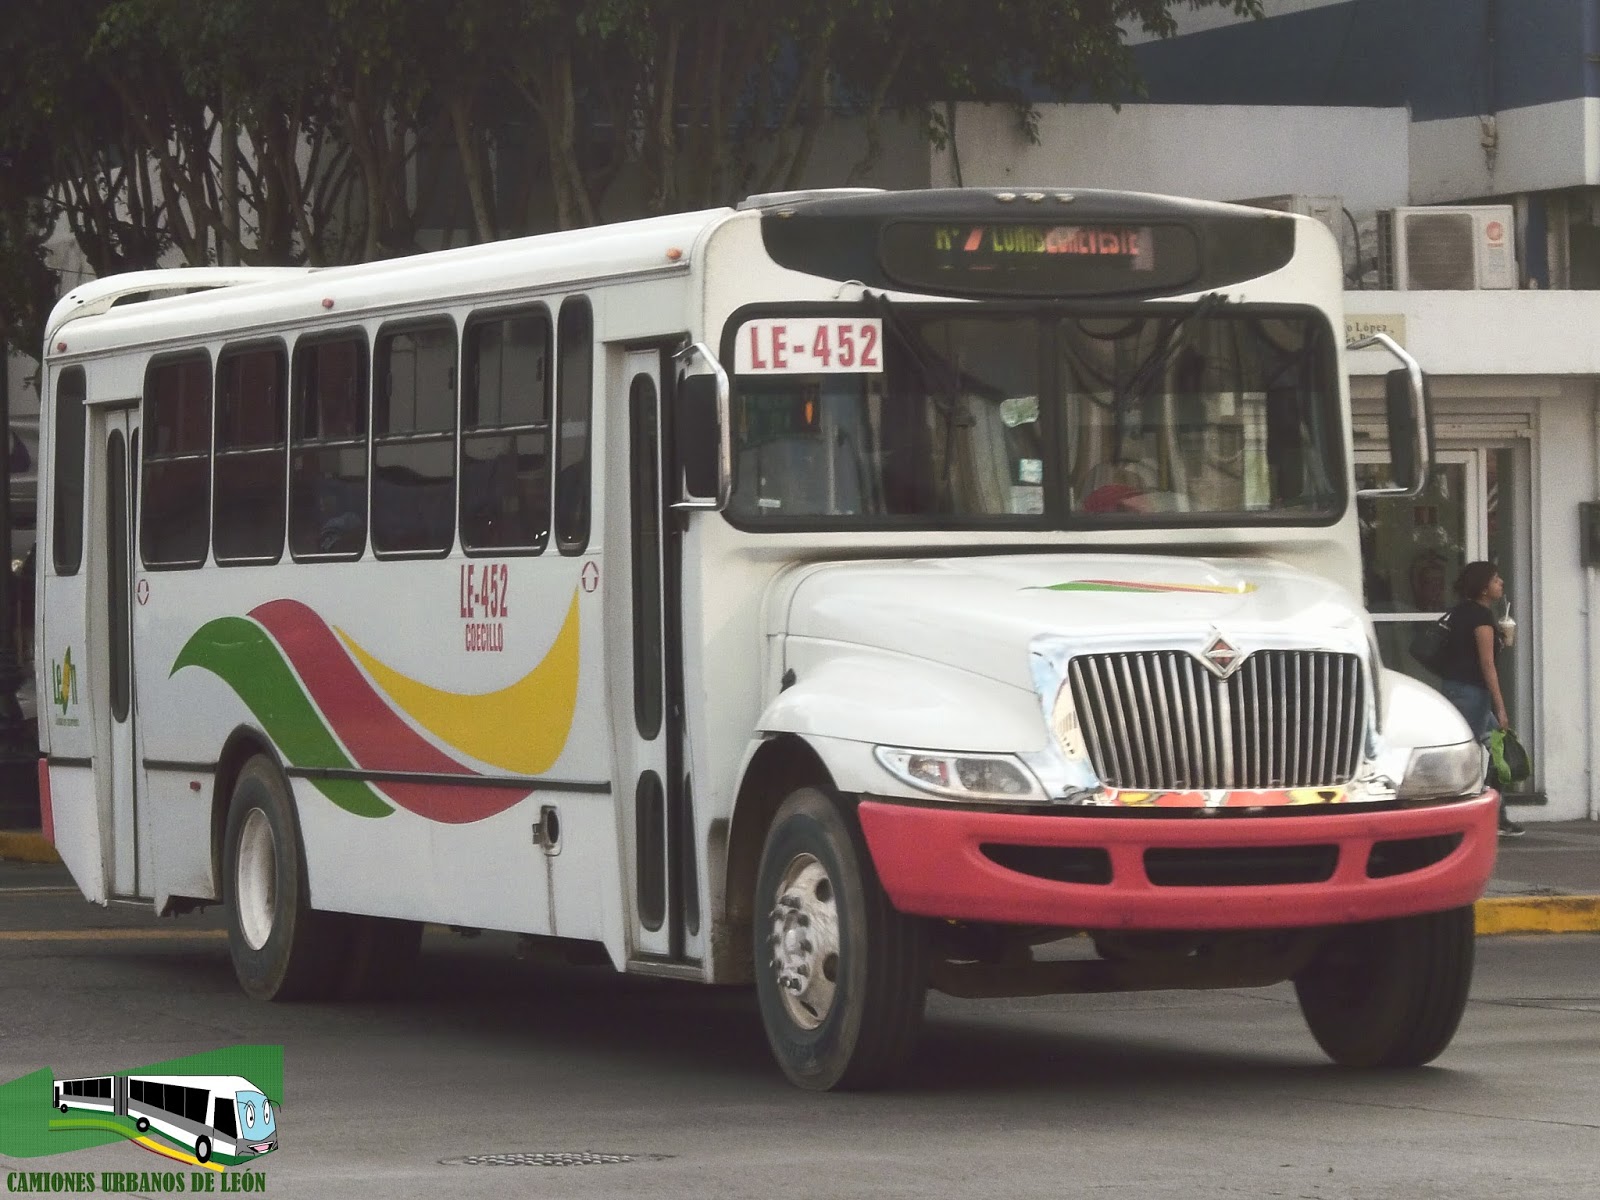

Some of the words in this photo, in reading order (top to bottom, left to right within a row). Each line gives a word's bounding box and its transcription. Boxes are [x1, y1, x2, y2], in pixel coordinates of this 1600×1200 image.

[751, 325, 877, 369] LE-452
[460, 564, 508, 618] LE-452
[465, 623, 504, 652] COECILLO
